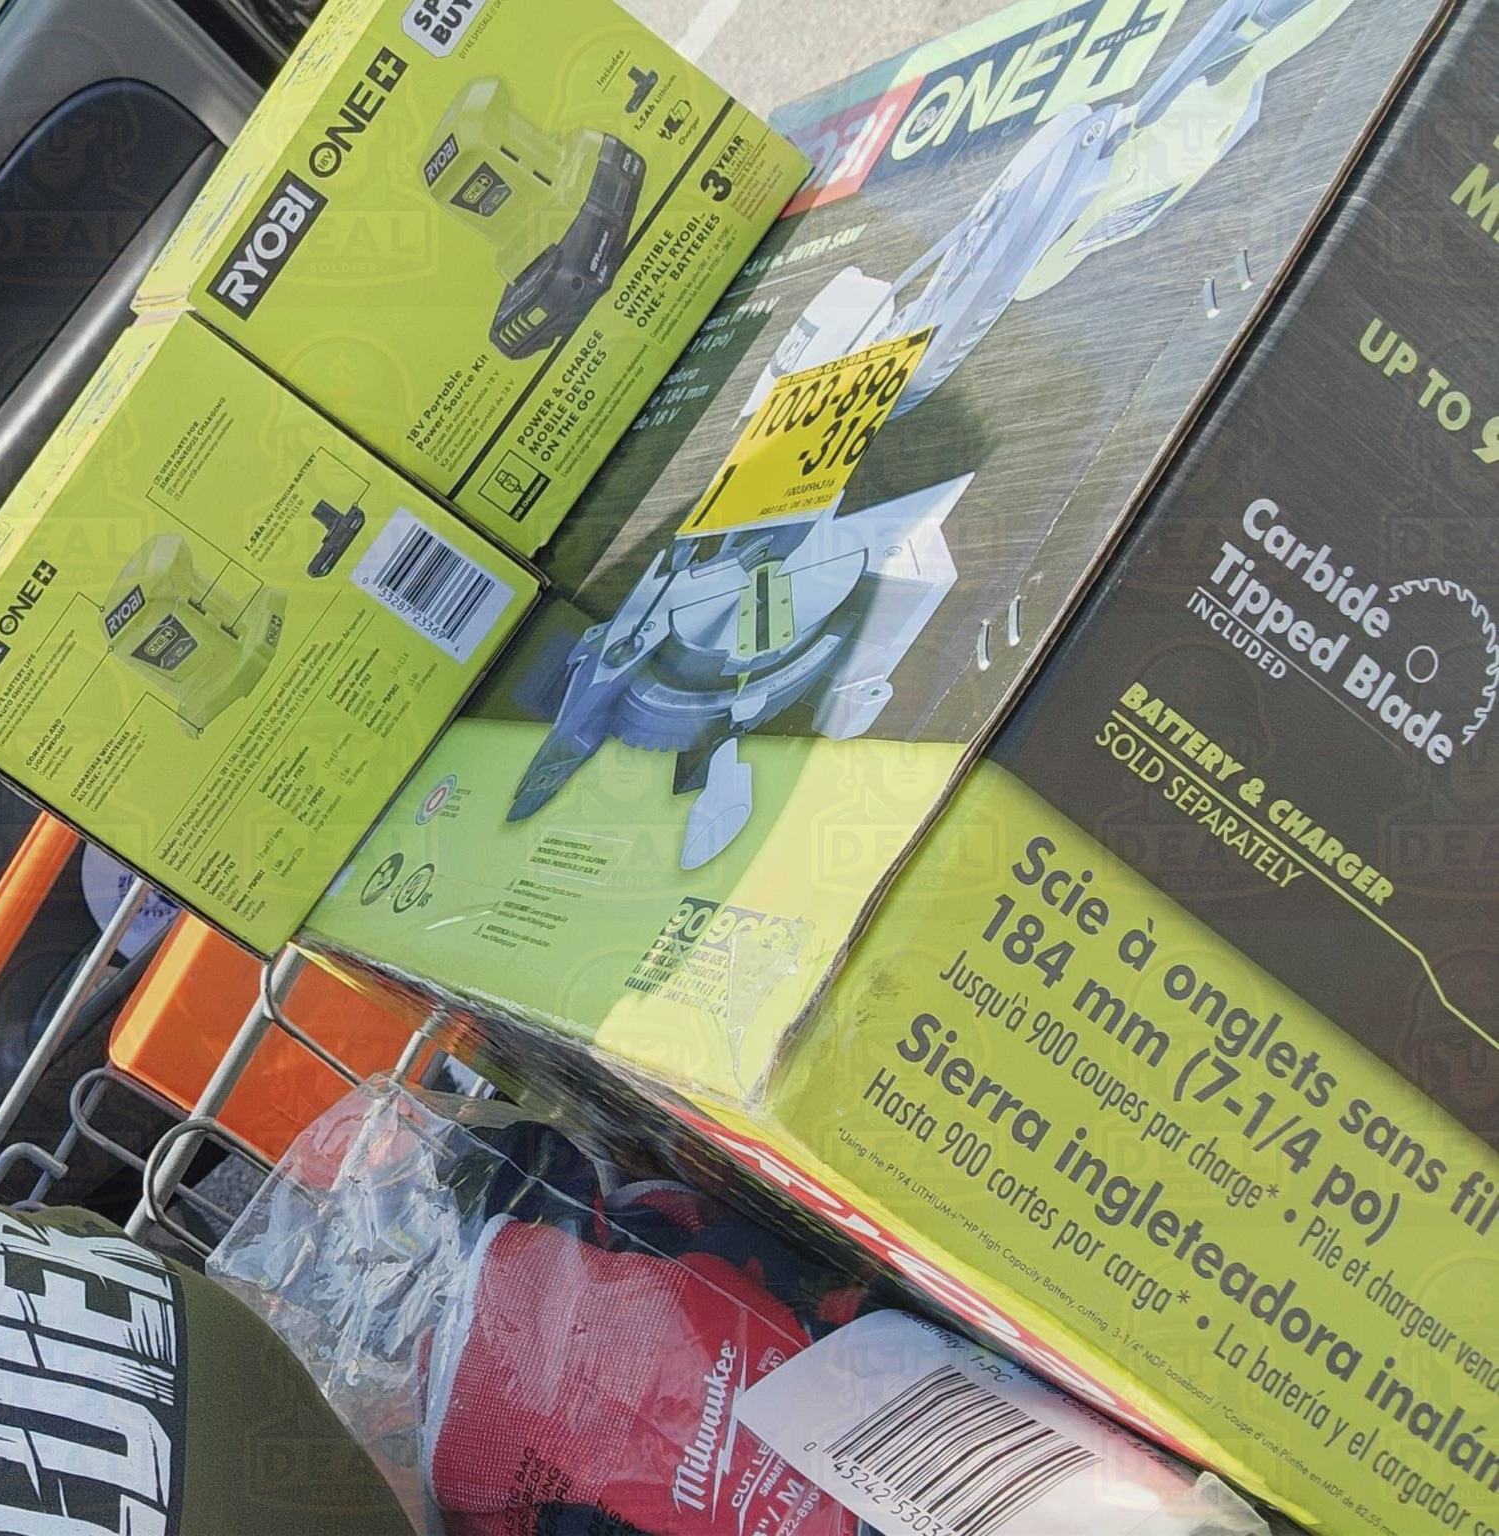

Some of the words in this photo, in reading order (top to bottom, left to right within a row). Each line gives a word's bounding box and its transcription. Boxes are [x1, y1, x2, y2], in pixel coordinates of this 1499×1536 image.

[596, 48, 625, 86] Includes
[633, 102, 656, 131] 1.5Ah
[653, 73, 677, 104] Lithium
[424, 138, 457, 181] RYOBI
[677, 115, 702, 146] Charger
[714, 134, 744, 171] YEAR
[695, 166, 736, 205] 3
[1451, 162, 1499, 244] M
[216, 182, 317, 310] RYOBI
[315, 148, 335, 171] 18V
[612, 228, 674, 311] COMPATIBLE
[669, 212, 721, 281] BATTERIES
[623, 284, 653, 320] WITH
[649, 257, 672, 284] ALL
[406, 419, 426, 443] 18V
[422, 367, 463, 420] Portable
[415, 413, 446, 452] Power
[442, 371, 475, 414] Source
[471, 352, 489, 373] Kit
[516, 397, 554, 446] POWER
[551, 385, 563, 398] &
[560, 328, 604, 385] CHARGE
[527, 402, 568, 455] MOBILE
[564, 348, 607, 404] DEVICES
[750, 350, 916, 441] 1003-896
[1359, 318, 1418, 377] UP
[1418, 368, 1471, 431] TO
[159, 435, 199, 489] SIMULTANEOUS
[196, 396, 226, 436] CHARGING
[539, 438, 560, 463] ON
[556, 411, 579, 439] THE
[575, 387, 597, 412] GO
[798, 409, 885, 476] -316
[243, 524, 266, 552] 1.5Ah
[263, 512, 275, 525] 18V
[272, 482, 295, 512] LITHIUM
[293, 453, 316, 483] BATTERY
[1243, 498, 1398, 638] Carbide
[106, 589, 143, 634] RYOBI
[360, 576, 369, 585] 0
[377, 586, 412, 615] 33287
[412, 612, 446, 641] 23369
[453, 644, 460, 652] 4
[1186, 592, 1286, 679] INCLUDED
[1198, 541, 1350, 673] Tipped
[1343, 654, 1469, 764] Blade
[3, 667, 26, 697] BATTERY
[23, 653, 36, 668] LIFE
[10, 667, 36, 700] SHUTOFF
[69, 756, 102, 797] COMPATIBLE
[98, 737, 115, 757] WITH
[1095, 722, 1164, 782] SOLD
[1163, 776, 1304, 887] SEPARATELY
[1120, 682, 1245, 781] BATTERY
[1239, 778, 1265, 808] &
[1268, 799, 1393, 906] CHARGER
[982, 894, 1075, 989] 184
[1072, 978, 1170, 1067] mm
[1173, 1047, 1322, 1175] (7-1/4
[1311, 1164, 1400, 1247] po)
[1011, 835, 1109, 936] Scie
[1118, 917, 1157, 972] à
[1164, 964, 1337, 1108] onglets
[1338, 1099, 1447, 1193] sans
[1450, 1171, 1498, 1236] fil
[939, 950, 1028, 1032] Jusqu'à
[1025, 1011, 1078, 1066] 900
[1071, 1056, 1149, 1123] coupes
[1140, 1111, 1191, 1152] par
[1298, 1215, 1343, 1269] Pile
[1342, 1258, 1371, 1287] et
[1365, 1269, 1457, 1353] chargeur
[896, 1013, 1051, 1152] Sierra
[1054, 1127, 1363, 1382] ingleteadora
[863, 1067, 937, 1143] Hasta
[937, 1122, 992, 1177] 900
[987, 1168, 1059, 1230] cortes
[1052, 1219, 1105, 1262] por
[1213, 1323, 1248, 1369] La
[1246, 1345, 1331, 1430] batería
[1323, 1417, 1350, 1447] y
[1347, 1428, 1380, 1461] el
[1372, 1450, 1471, 1531] cargador
[866, 1150, 887, 1168] the
[884, 1163, 912, 1187] P194
[975, 1229, 1003, 1253] High
[998, 1247, 1043, 1284] Capacity
[1040, 1276, 1079, 1309] Battery,
[1075, 1301, 1110, 1331] cutting
[1141, 1349, 1166, 1371] MDF
[1163, 1365, 1214, 1405] baseboard
[1251, 1429, 1281, 1454] d'une
[1278, 1448, 1311, 1476] Plinthe
[1307, 1471, 1322, 1485] en
[1319, 1478, 1343, 1500] MDF
[1340, 1494, 1356, 1509] de
[1352, 1503, 1383, 1529] 82,55
[968, 1352, 1013, 1386] 1-PC
[513, 1446, 536, 1483] BAG
[672, 1345, 738, 1514] Milwaukee
[732, 1469, 756, 1508] CUT
[776, 1477, 806, 1507] M
[803, 1442, 818, 1452] 0
[833, 1460, 891, 1504] 45242
